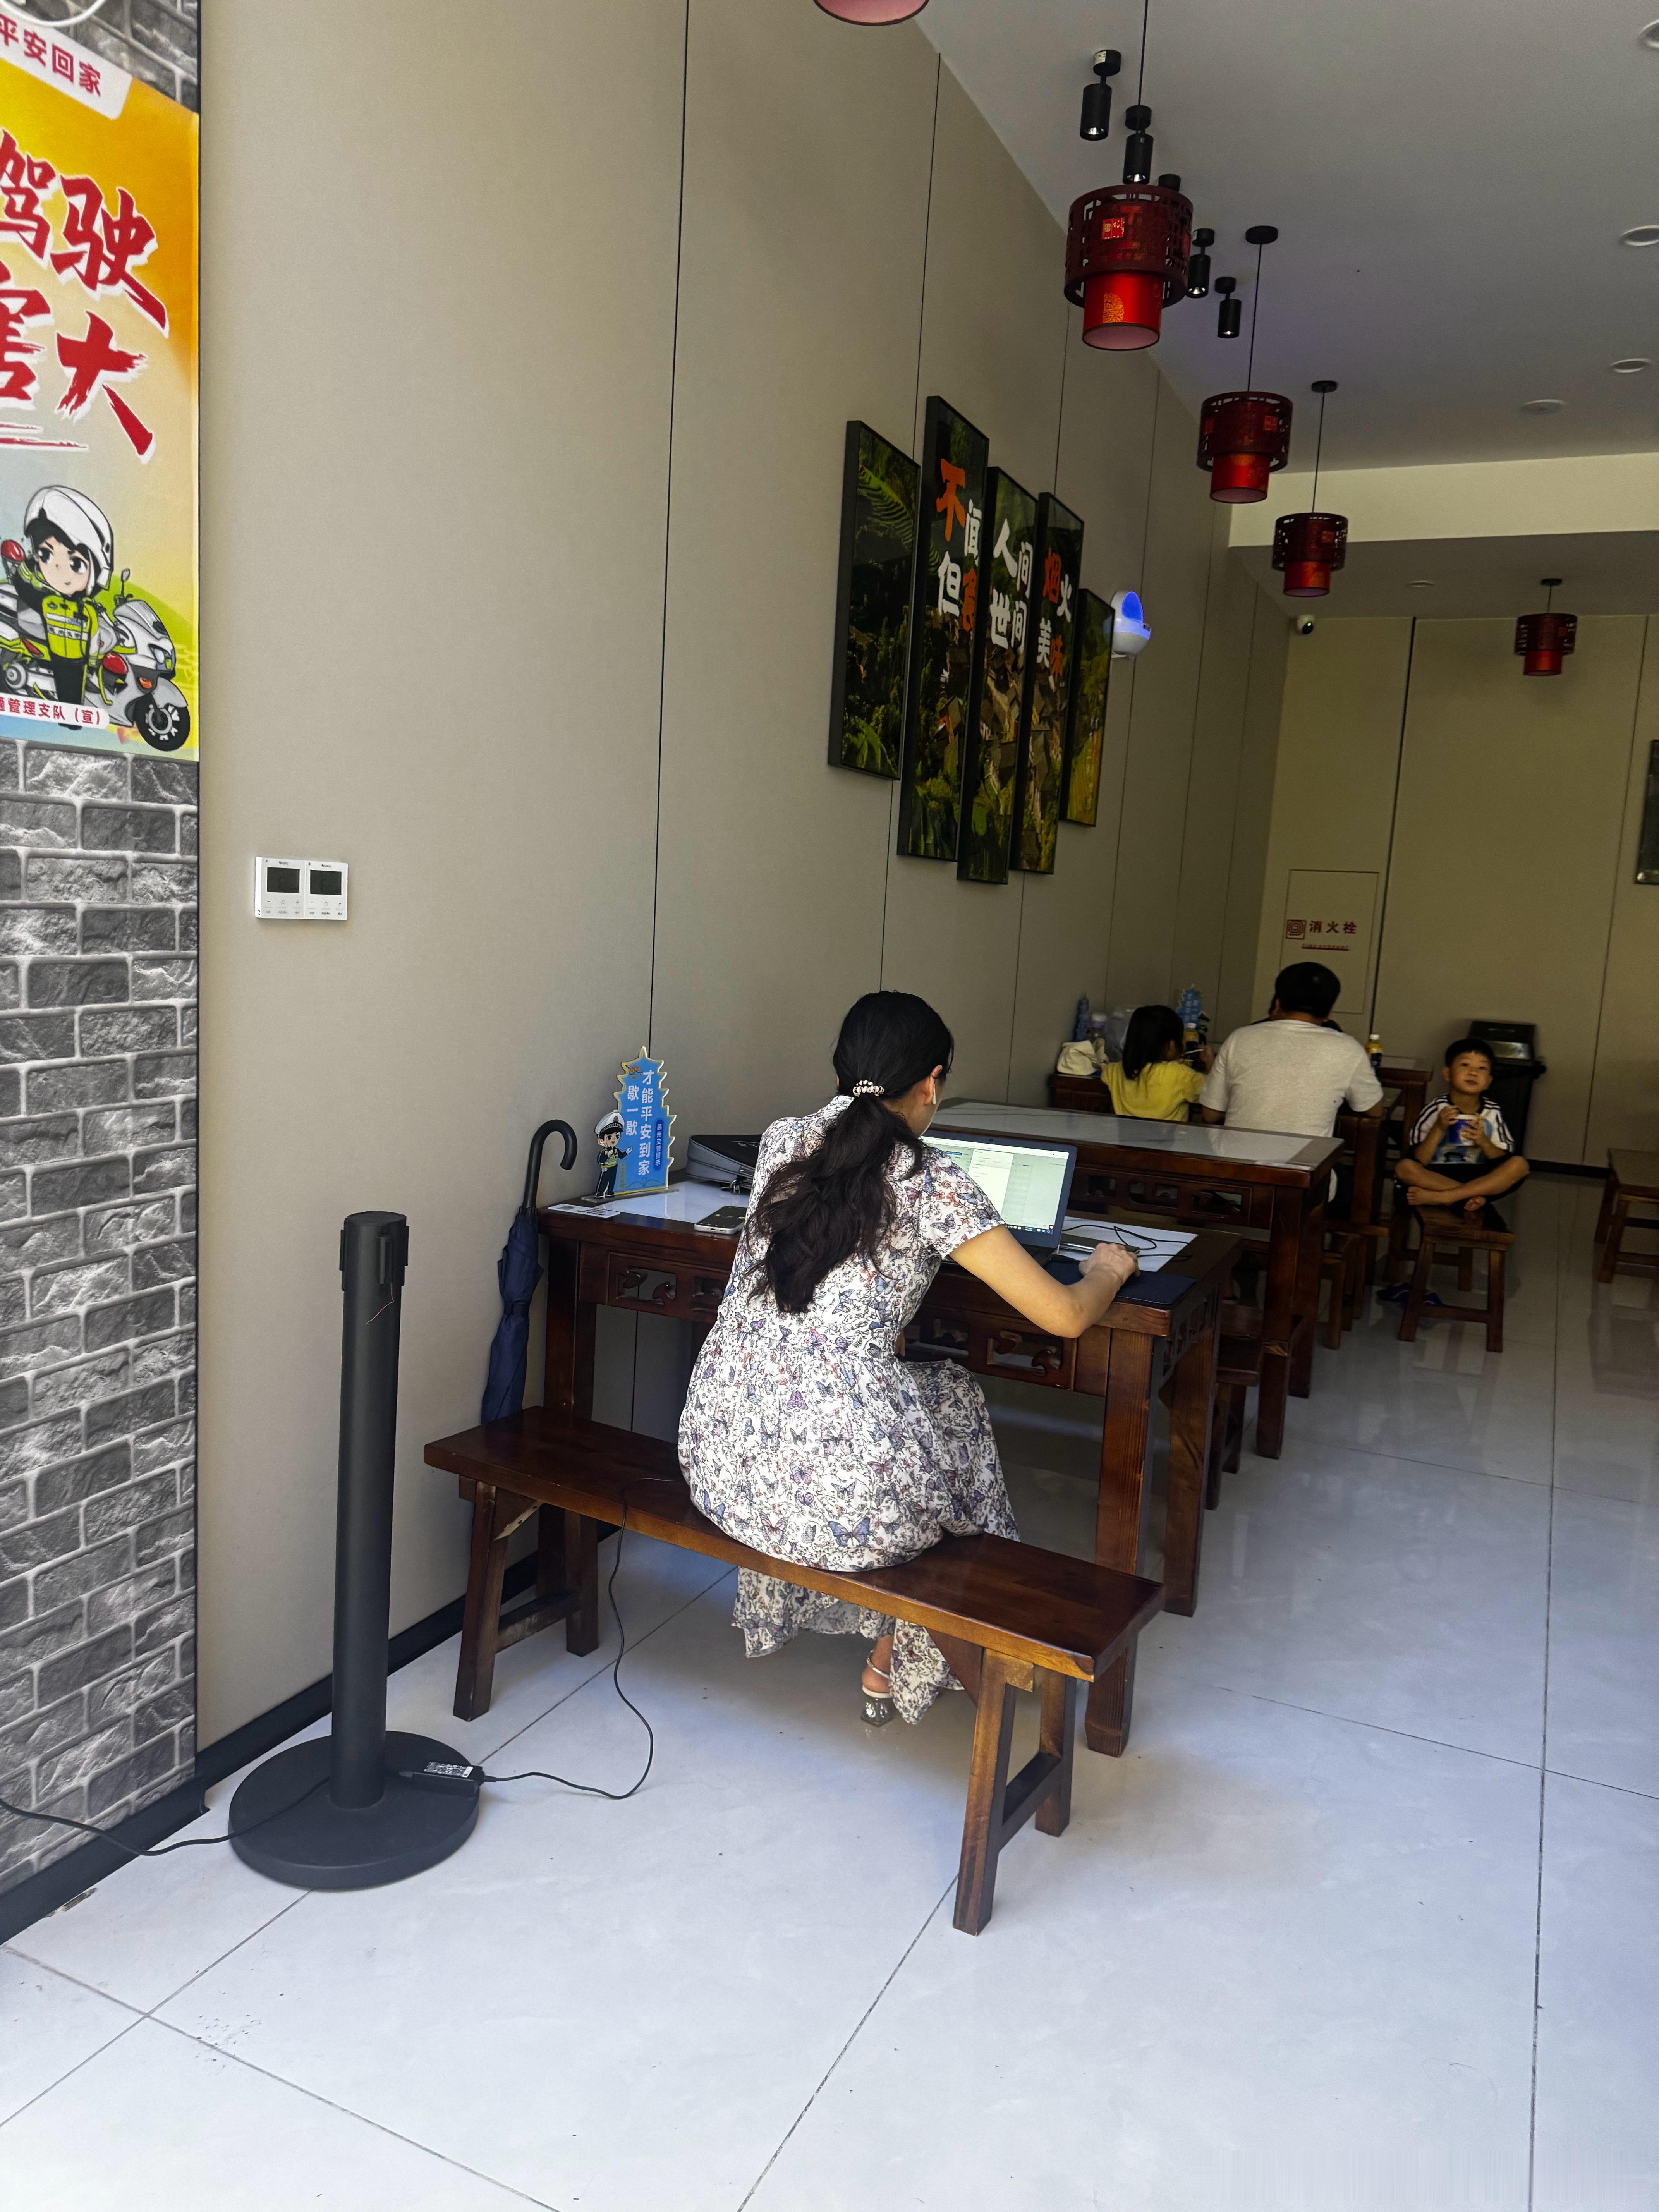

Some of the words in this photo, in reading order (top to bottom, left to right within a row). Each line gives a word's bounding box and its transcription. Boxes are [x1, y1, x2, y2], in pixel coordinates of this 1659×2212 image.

[0, 14, 101, 97] 平安回家
[0, 129, 169, 330] 驾驶
[1309, 921, 1357, 934] 消火栓
[626, 1085, 639, 1136] 歇一歇
[638, 1070, 654, 1175] 才能平安到家
